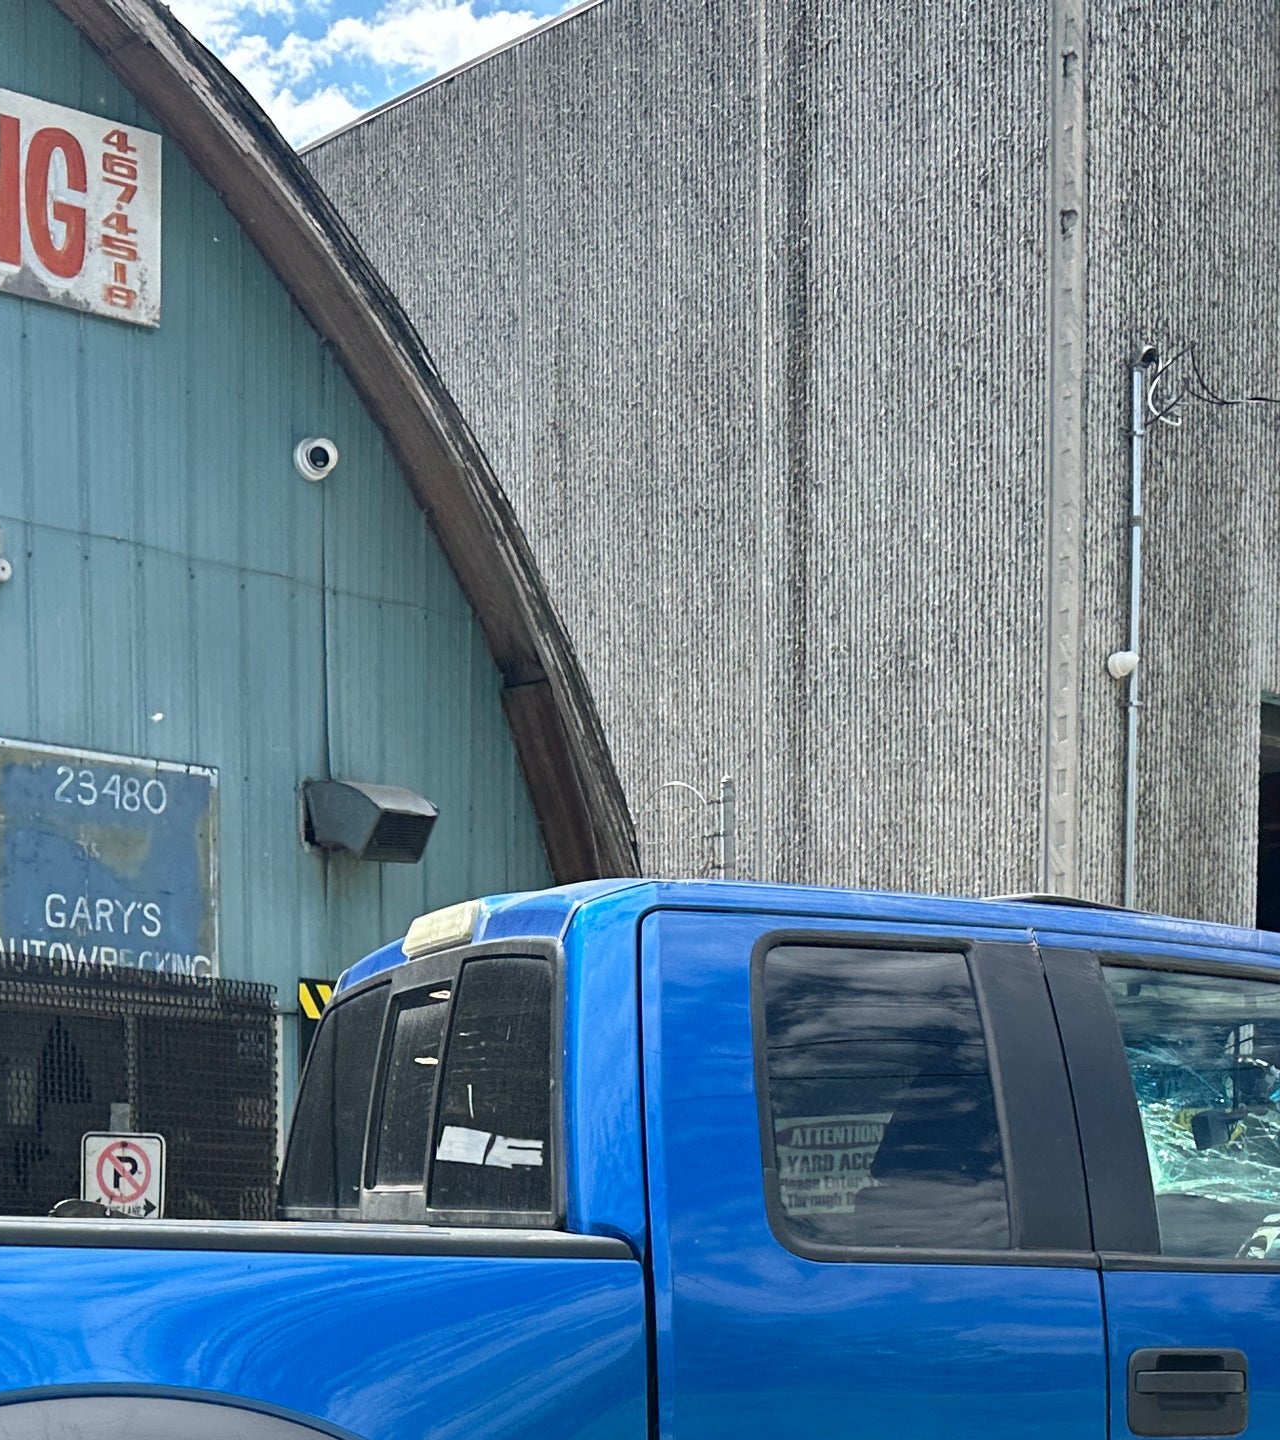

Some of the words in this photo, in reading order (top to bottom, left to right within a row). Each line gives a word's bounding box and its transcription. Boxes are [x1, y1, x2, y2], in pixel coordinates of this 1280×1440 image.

[54, 766, 167, 814] 23480
[45, 893, 161, 937] GARY'S
[790, 1124, 885, 1147] ATTENTION
[787, 1153, 835, 1173] YARD
[839, 1152, 875, 1171] ACC
